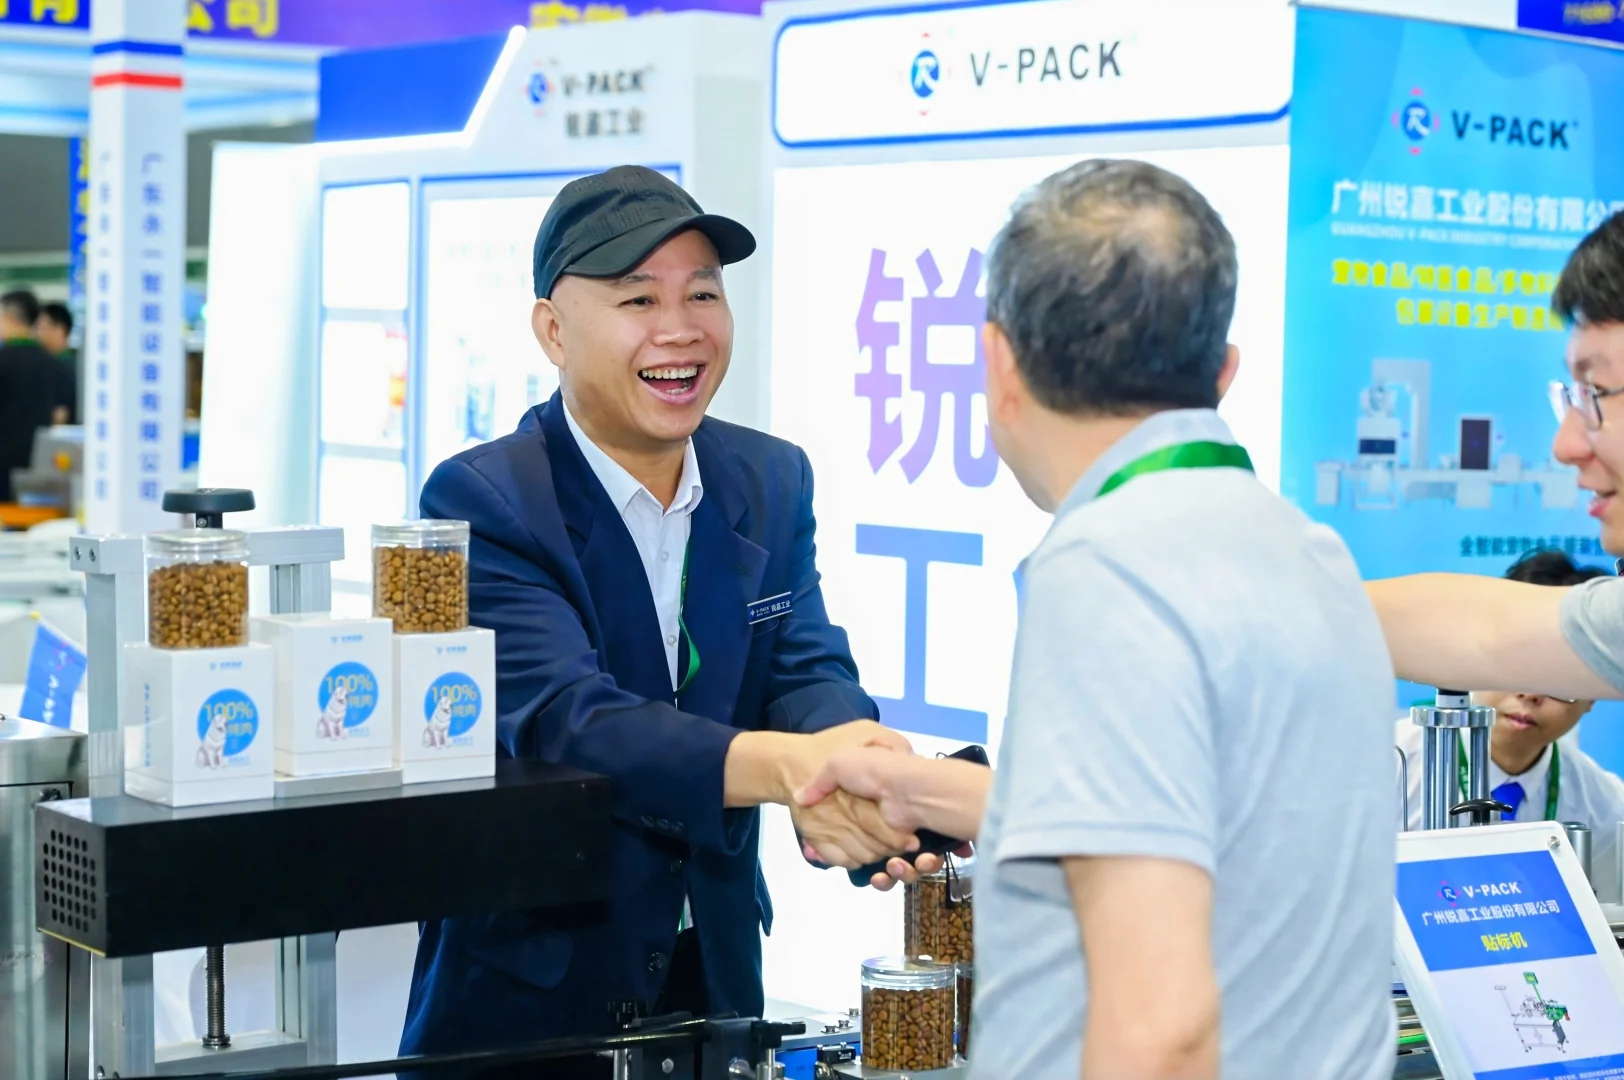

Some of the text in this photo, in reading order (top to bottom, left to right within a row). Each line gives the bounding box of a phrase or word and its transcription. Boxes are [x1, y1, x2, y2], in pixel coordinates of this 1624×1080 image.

[970, 40, 1121, 86] V-PACK
[562, 70, 645, 97] V-PACK
[1452, 109, 1569, 149] V-PACK
[854, 247, 999, 488] 锐
[855, 523, 988, 745] 工
[1462, 881, 1522, 898] V-PACK
[1421, 899, 1560, 926] 广州锐嘉工业股份有限公司
[1480, 931, 1528, 952] 贴标机
